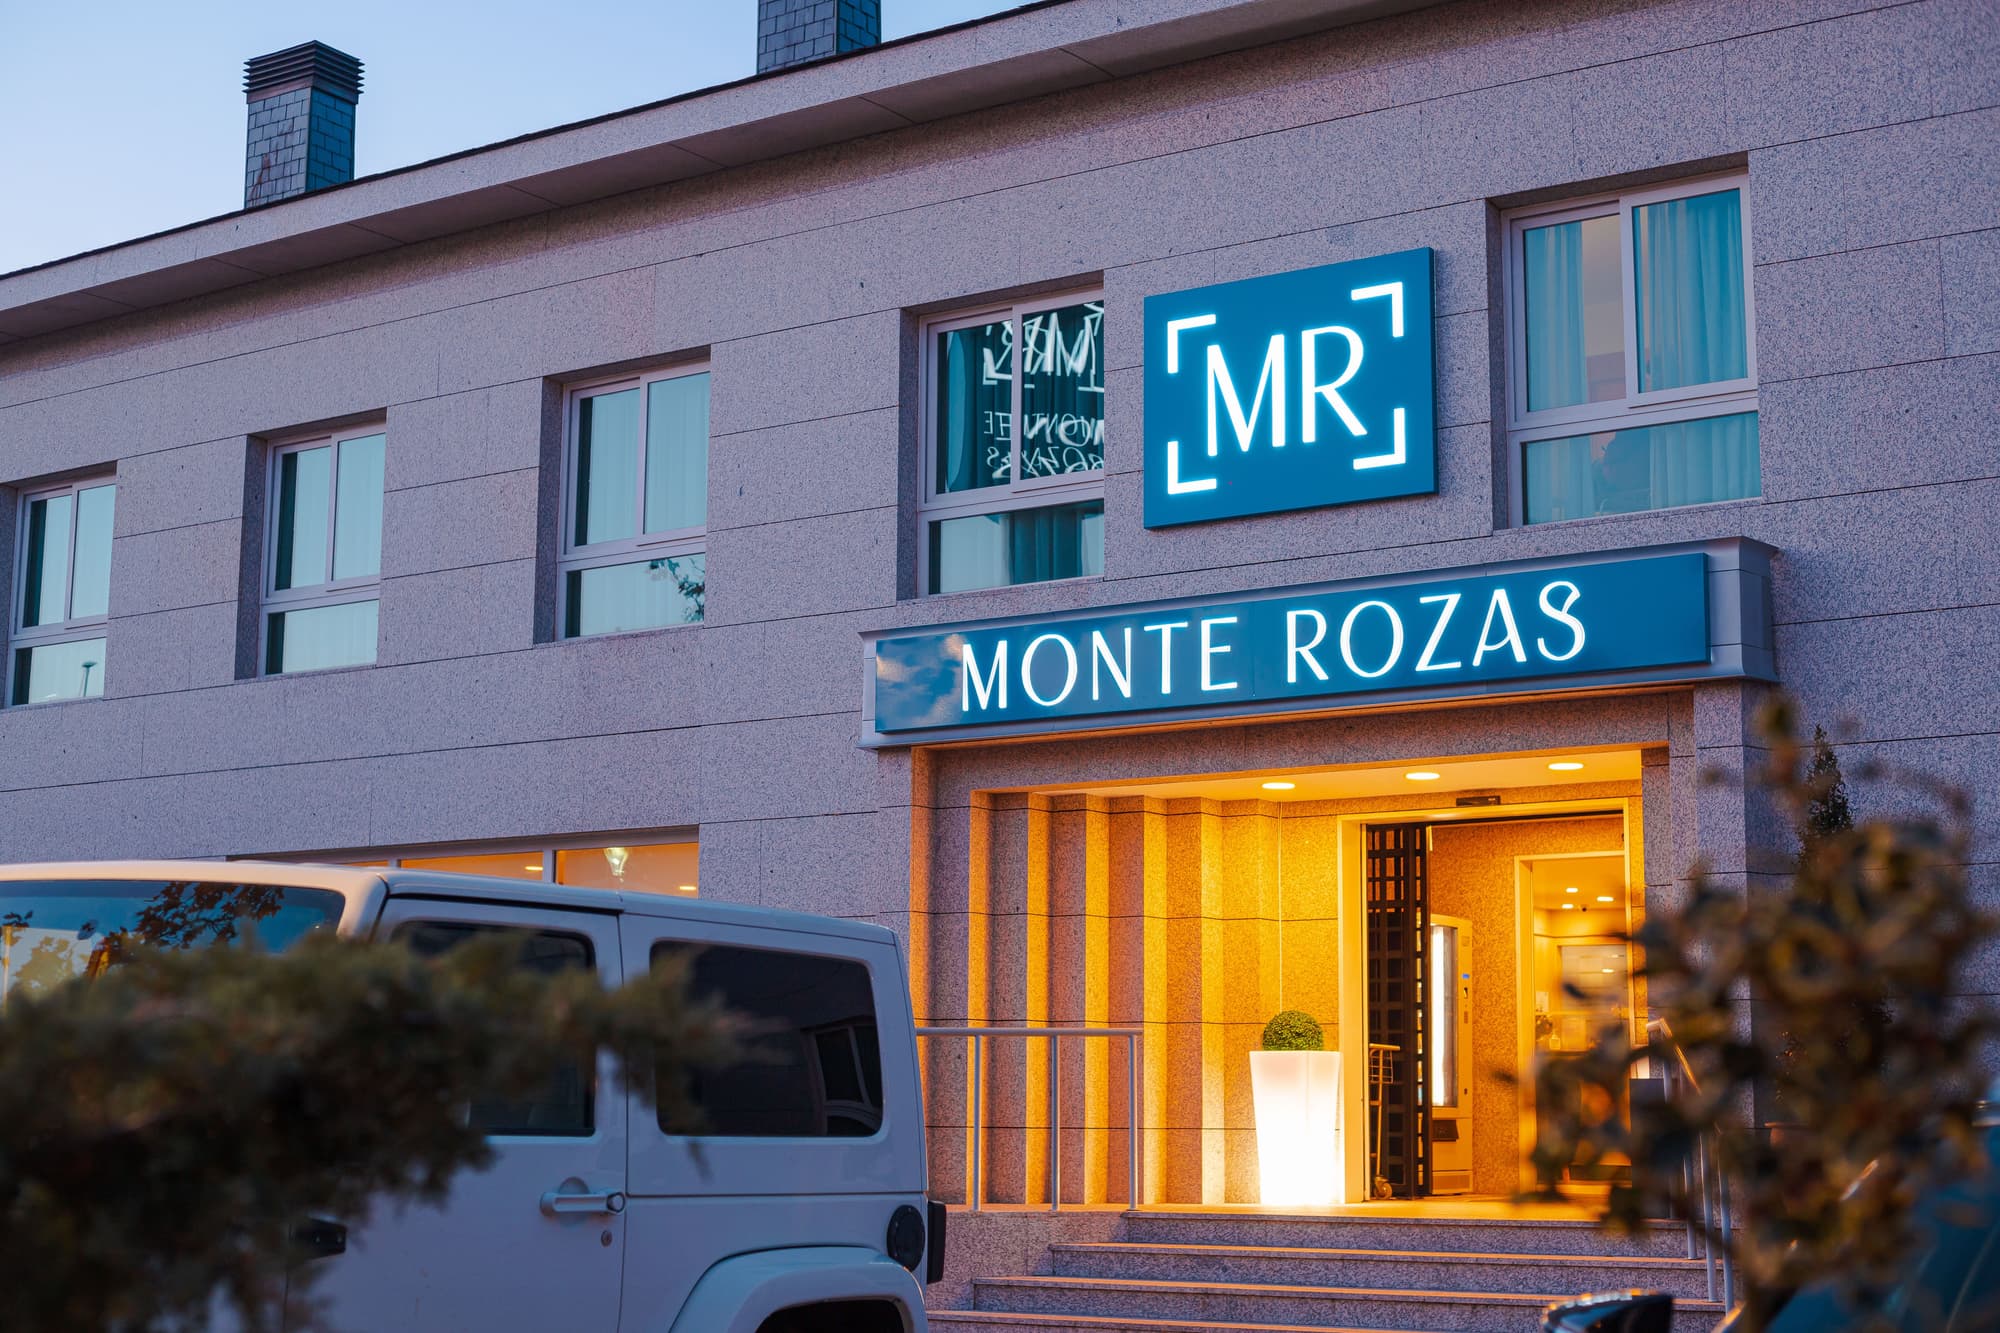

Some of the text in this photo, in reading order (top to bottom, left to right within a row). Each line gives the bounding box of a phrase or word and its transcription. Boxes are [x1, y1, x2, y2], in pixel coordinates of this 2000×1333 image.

[1206, 325, 1368, 457] MR
[960, 581, 1586, 712] MONTE ROZAS
